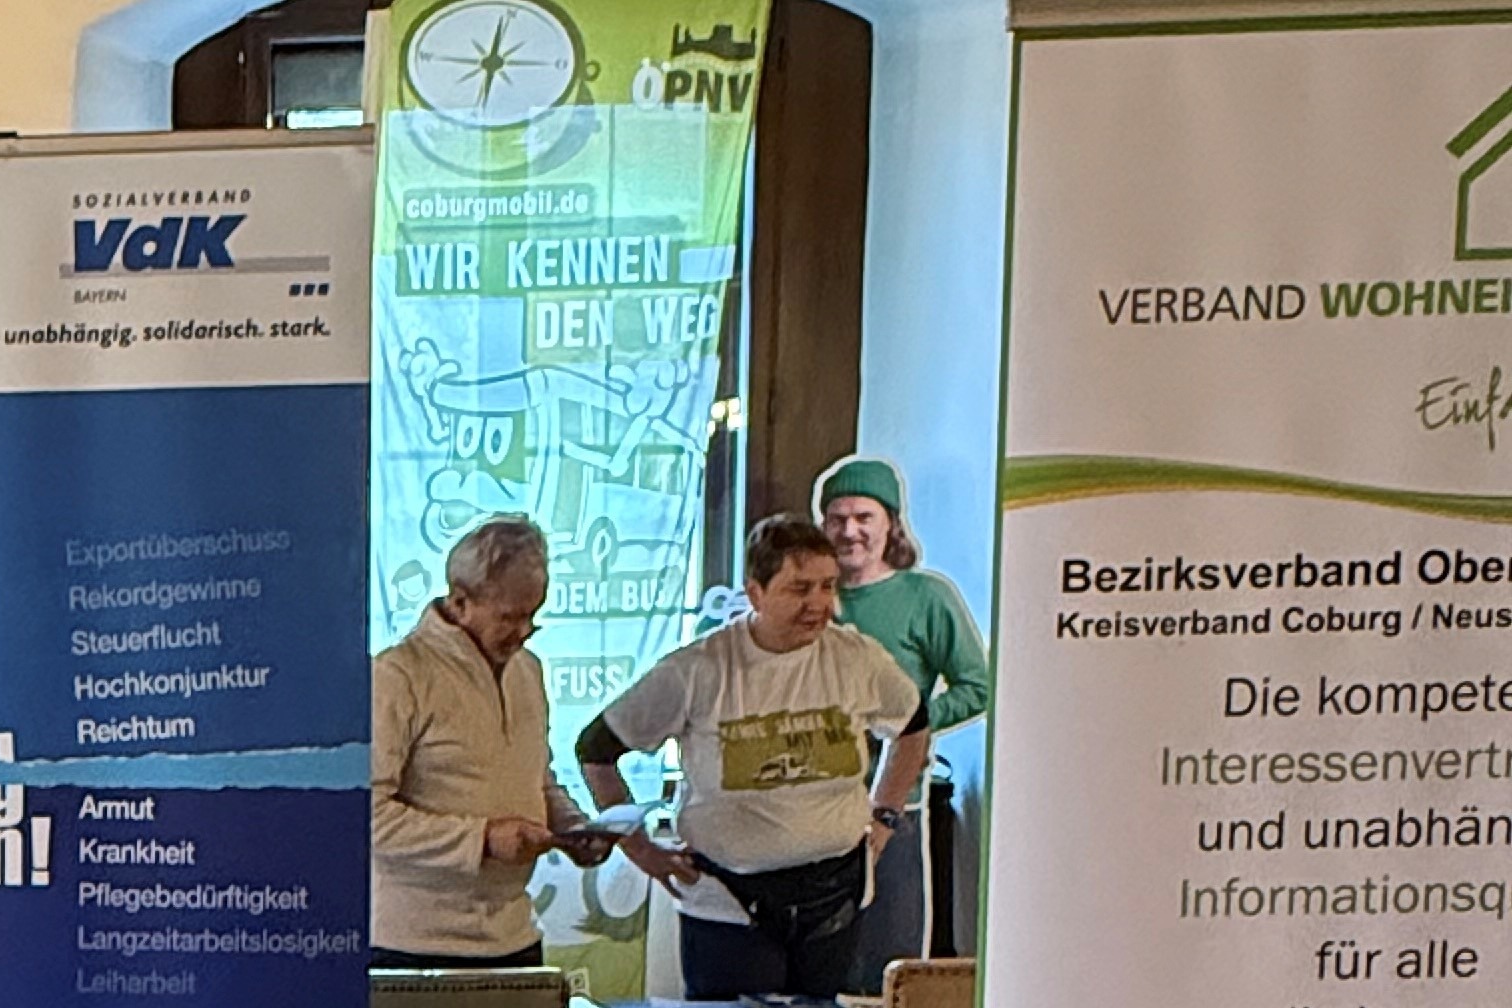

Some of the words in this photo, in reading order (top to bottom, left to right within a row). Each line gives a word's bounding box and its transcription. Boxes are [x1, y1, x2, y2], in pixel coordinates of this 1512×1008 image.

[632, 56, 753, 113] ÖPNV
[73, 188, 252, 210] SOZIALVERBAND
[406, 189, 589, 222] coburgmobil.de
[74, 213, 248, 272] VdK
[406, 241, 481, 290] WIR
[507, 234, 671, 289] KENNEN
[74, 288, 127, 304] BAYERN
[1098, 284, 1306, 325] VERBAND
[4, 320, 137, 349] unabhängig.
[143, 317, 265, 342] solidarisch.
[270, 315, 331, 338] stark.
[535, 299, 615, 349] DEN
[643, 295, 720, 345] WEG
[66, 528, 291, 568] Exportüberschuss
[1062, 551, 1402, 594] Bezirksverband
[1417, 548, 1512, 586] Obe
[68, 575, 262, 611] Rekordgewinne
[549, 581, 608, 614] DEM
[1056, 606, 1271, 638] Kreisverband
[1282, 603, 1402, 637] Coburg
[1410, 603, 1424, 631] /
[1431, 602, 1512, 631] Neus
[71, 621, 222, 656] Steuerflucht
[74, 664, 270, 700] Hochkonjunktur
[1224, 677, 1301, 718] Die
[76, 715, 195, 745] Reichtum
[1161, 740, 1512, 786] Interessenvert
[78, 795, 155, 821] Armut
[1198, 810, 1286, 852] und
[1303, 805, 1512, 849] unabhän
[79, 838, 195, 865] Krankheit
[78, 881, 310, 915] Pflegebedürftigkeit
[77, 925, 360, 958] Langzeitarbeitslosigkeit
[1315, 940, 1382, 981] für
[1396, 939, 1479, 980] alle
[76, 968, 195, 996] Leiharbeit
